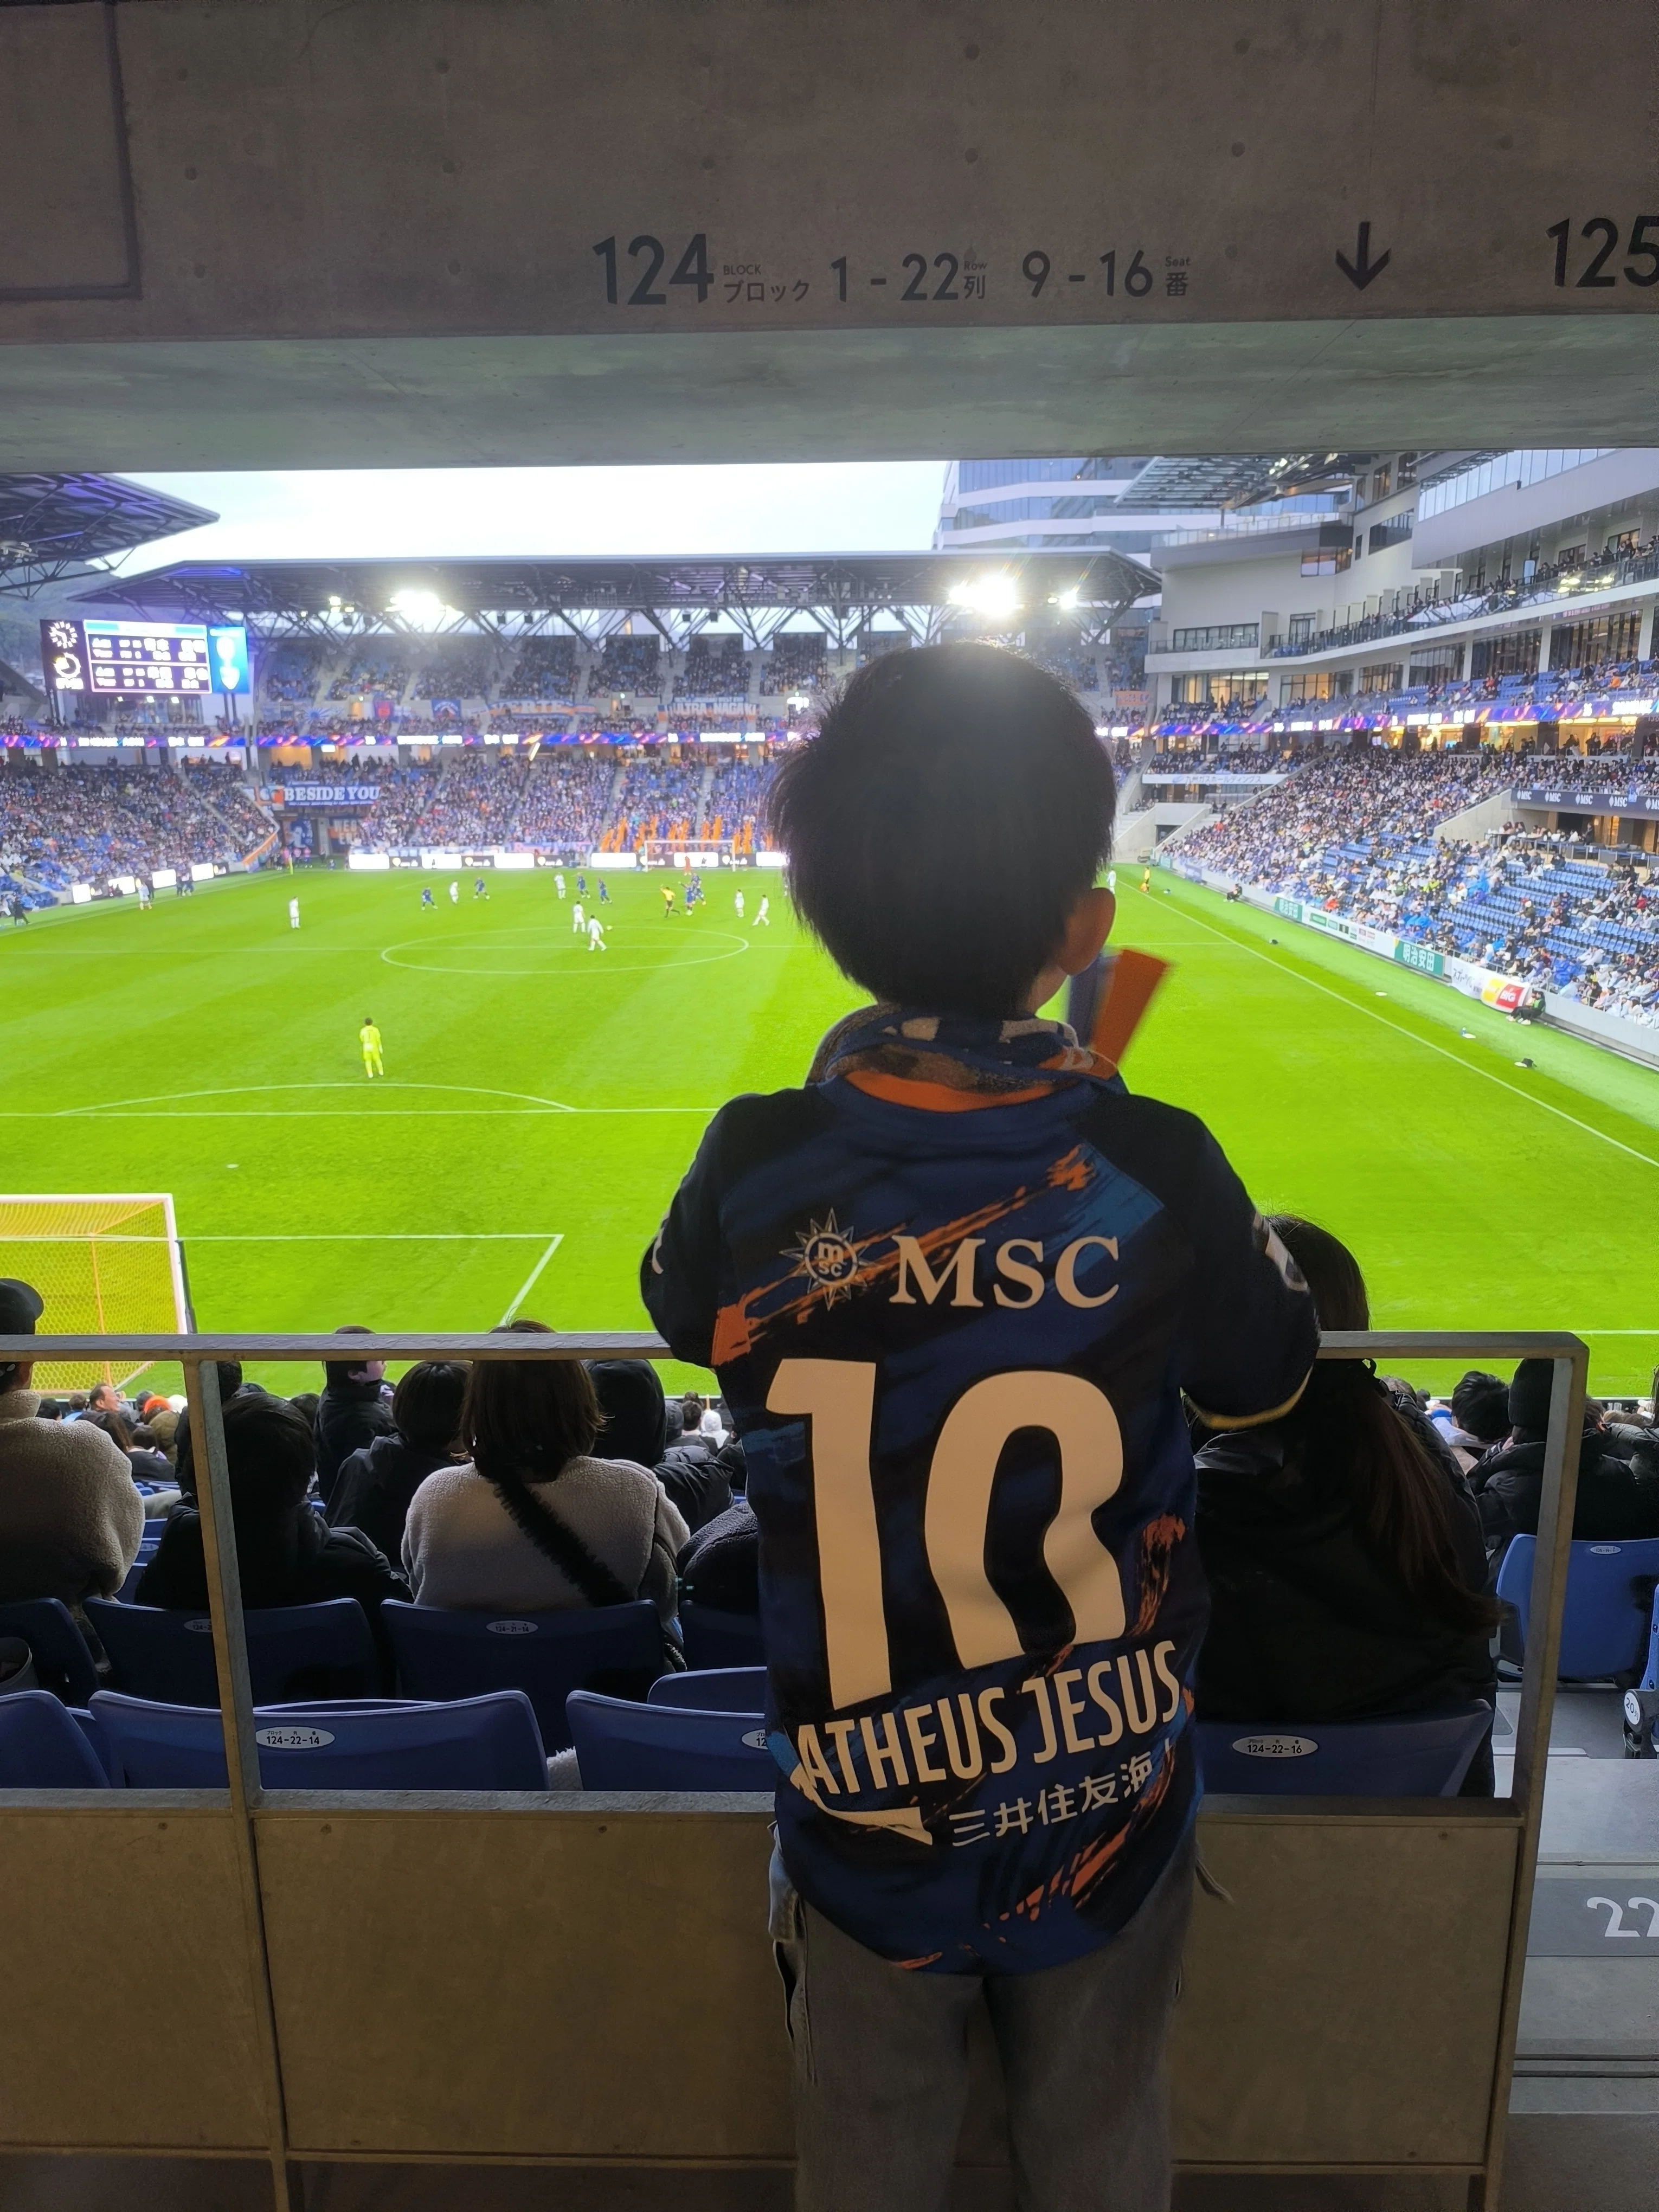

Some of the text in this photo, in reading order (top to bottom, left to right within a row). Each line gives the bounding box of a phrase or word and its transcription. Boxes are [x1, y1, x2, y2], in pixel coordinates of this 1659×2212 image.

[1546, 216, 1659, 287] 125
[963, 260, 988, 270] Row
[1165, 255, 1191, 267] Seat
[592, 234, 715, 305] 124
[723, 264, 761, 275] BLOCK
[724, 279, 810, 303] ブロック
[963, 274, 986, 299] 列
[1166, 272, 1189, 297] 番
[673, 702, 706, 715] ULTRA
[284, 787, 345, 801] BESIDE
[346, 786, 380, 800] YOU
[1521, 790, 1532, 800] MSC
[1549, 793, 1561, 802] MSC
[1580, 794, 1593, 805] MSC
[1613, 796, 1628, 807] MSC
[1651, 799, 1659, 810] MS
[1403, 943, 1435, 972] 明治安田
[889, 1234, 1120, 1309] MSC
[766, 1358, 1126, 1711] 10
[796, 1640, 1182, 1795] ATHEUS JESUS
[266, 1736, 320, 1745] 124-22-14
[756, 1738, 767, 1746] 12
[1247, 1744, 1302, 1754] 124-22-16
[949, 1749, 1154, 1847] 三井住友海
[1586, 1896, 1659, 1937] 22
